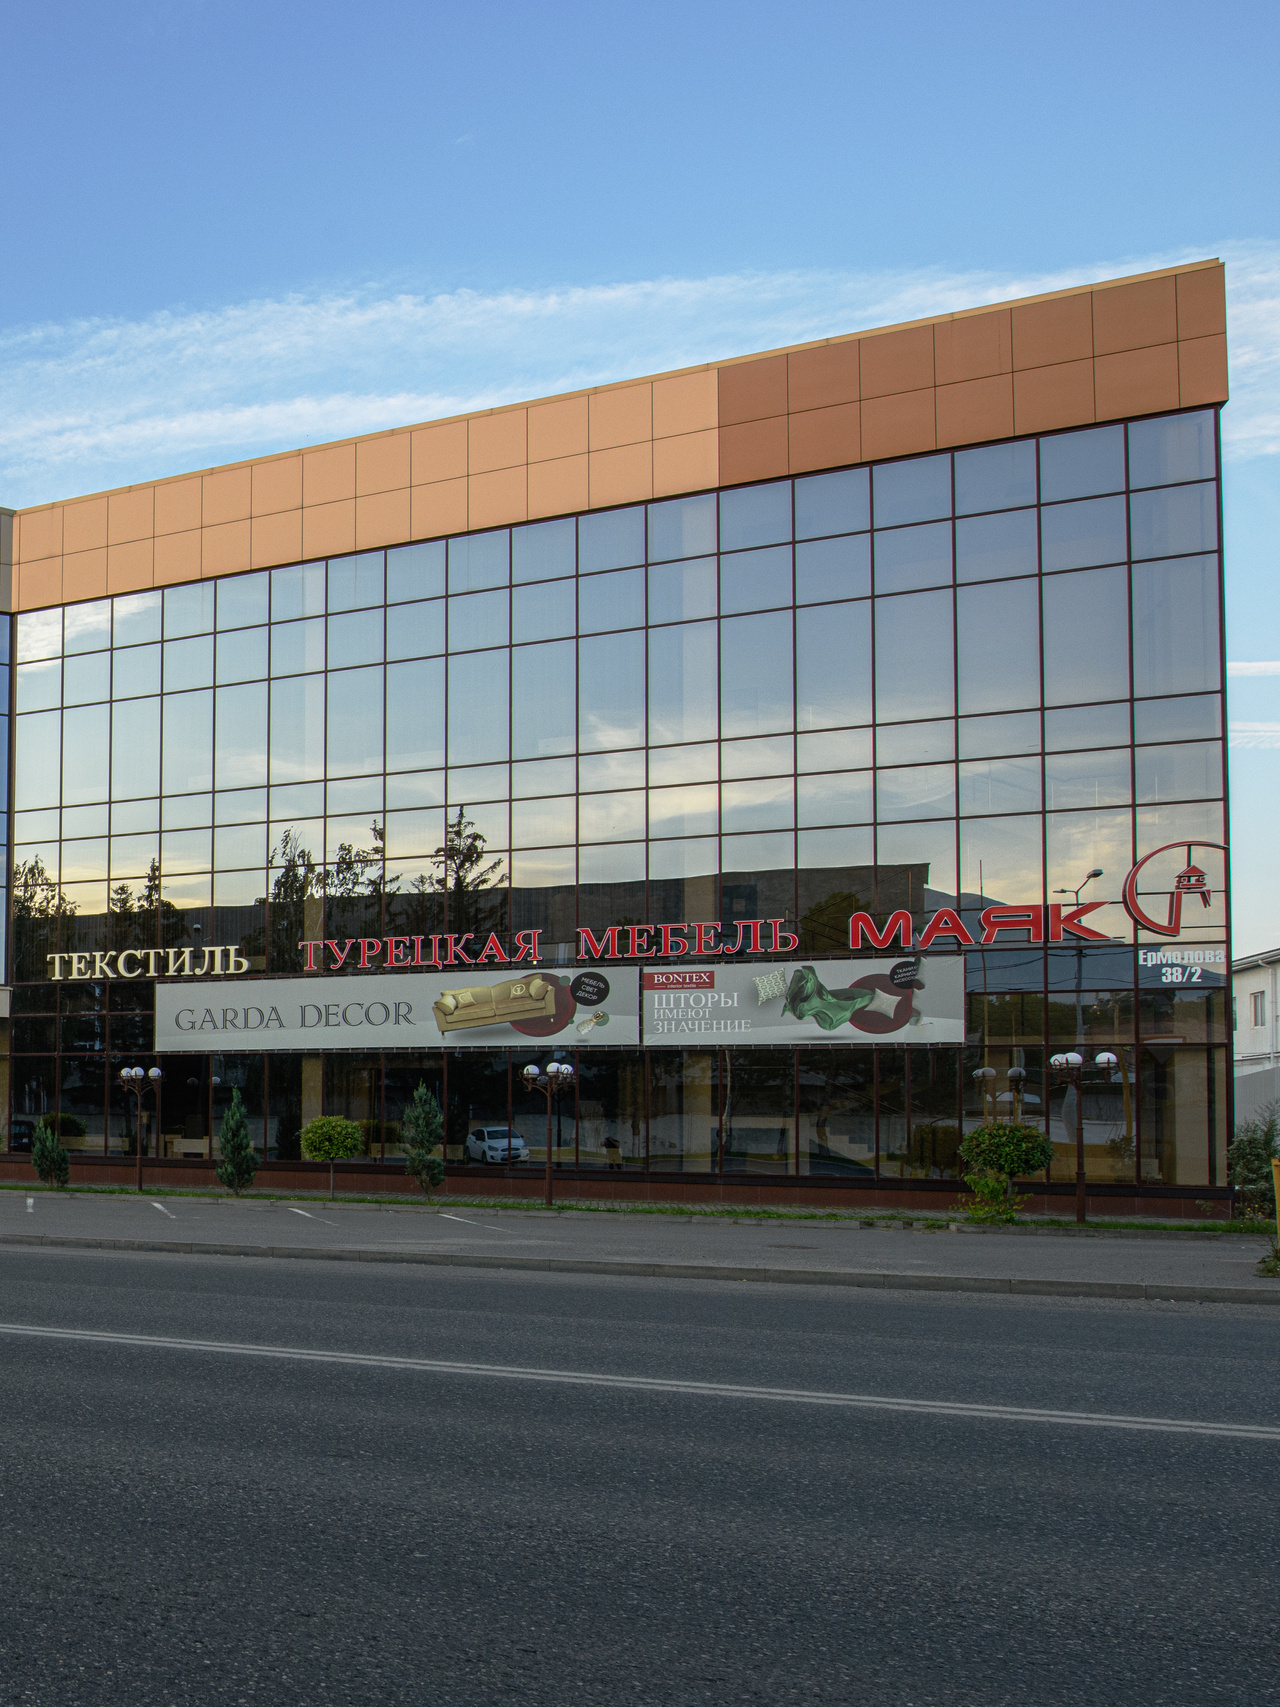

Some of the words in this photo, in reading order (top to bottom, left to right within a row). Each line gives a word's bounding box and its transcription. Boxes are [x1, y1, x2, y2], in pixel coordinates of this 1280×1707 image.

[849, 901, 1115, 949] МАЯК
[298, 929, 543, 970] ТУРЕЦКАЯ
[576, 918, 799, 959] МЕБЕЛЬ
[46, 945, 251, 981] ТЕКСТИЛЬ
[1138, 949, 1226, 967] Ермолова
[581, 977, 605, 989] МЕБЕЛЬ
[653, 972, 710, 984] BONTEX
[1161, 966, 1202, 983] 38/2
[576, 990, 598, 1000] ДЕКОР
[581, 984, 598, 993] СВЕТ
[654, 992, 739, 1009] ШТОРЫ
[174, 1006, 286, 1032] GARDA
[299, 1001, 417, 1028] DECOR
[654, 1008, 712, 1019] ИМЕЮТ
[653, 1020, 752, 1034] ЗНАЧЕНИЕ
